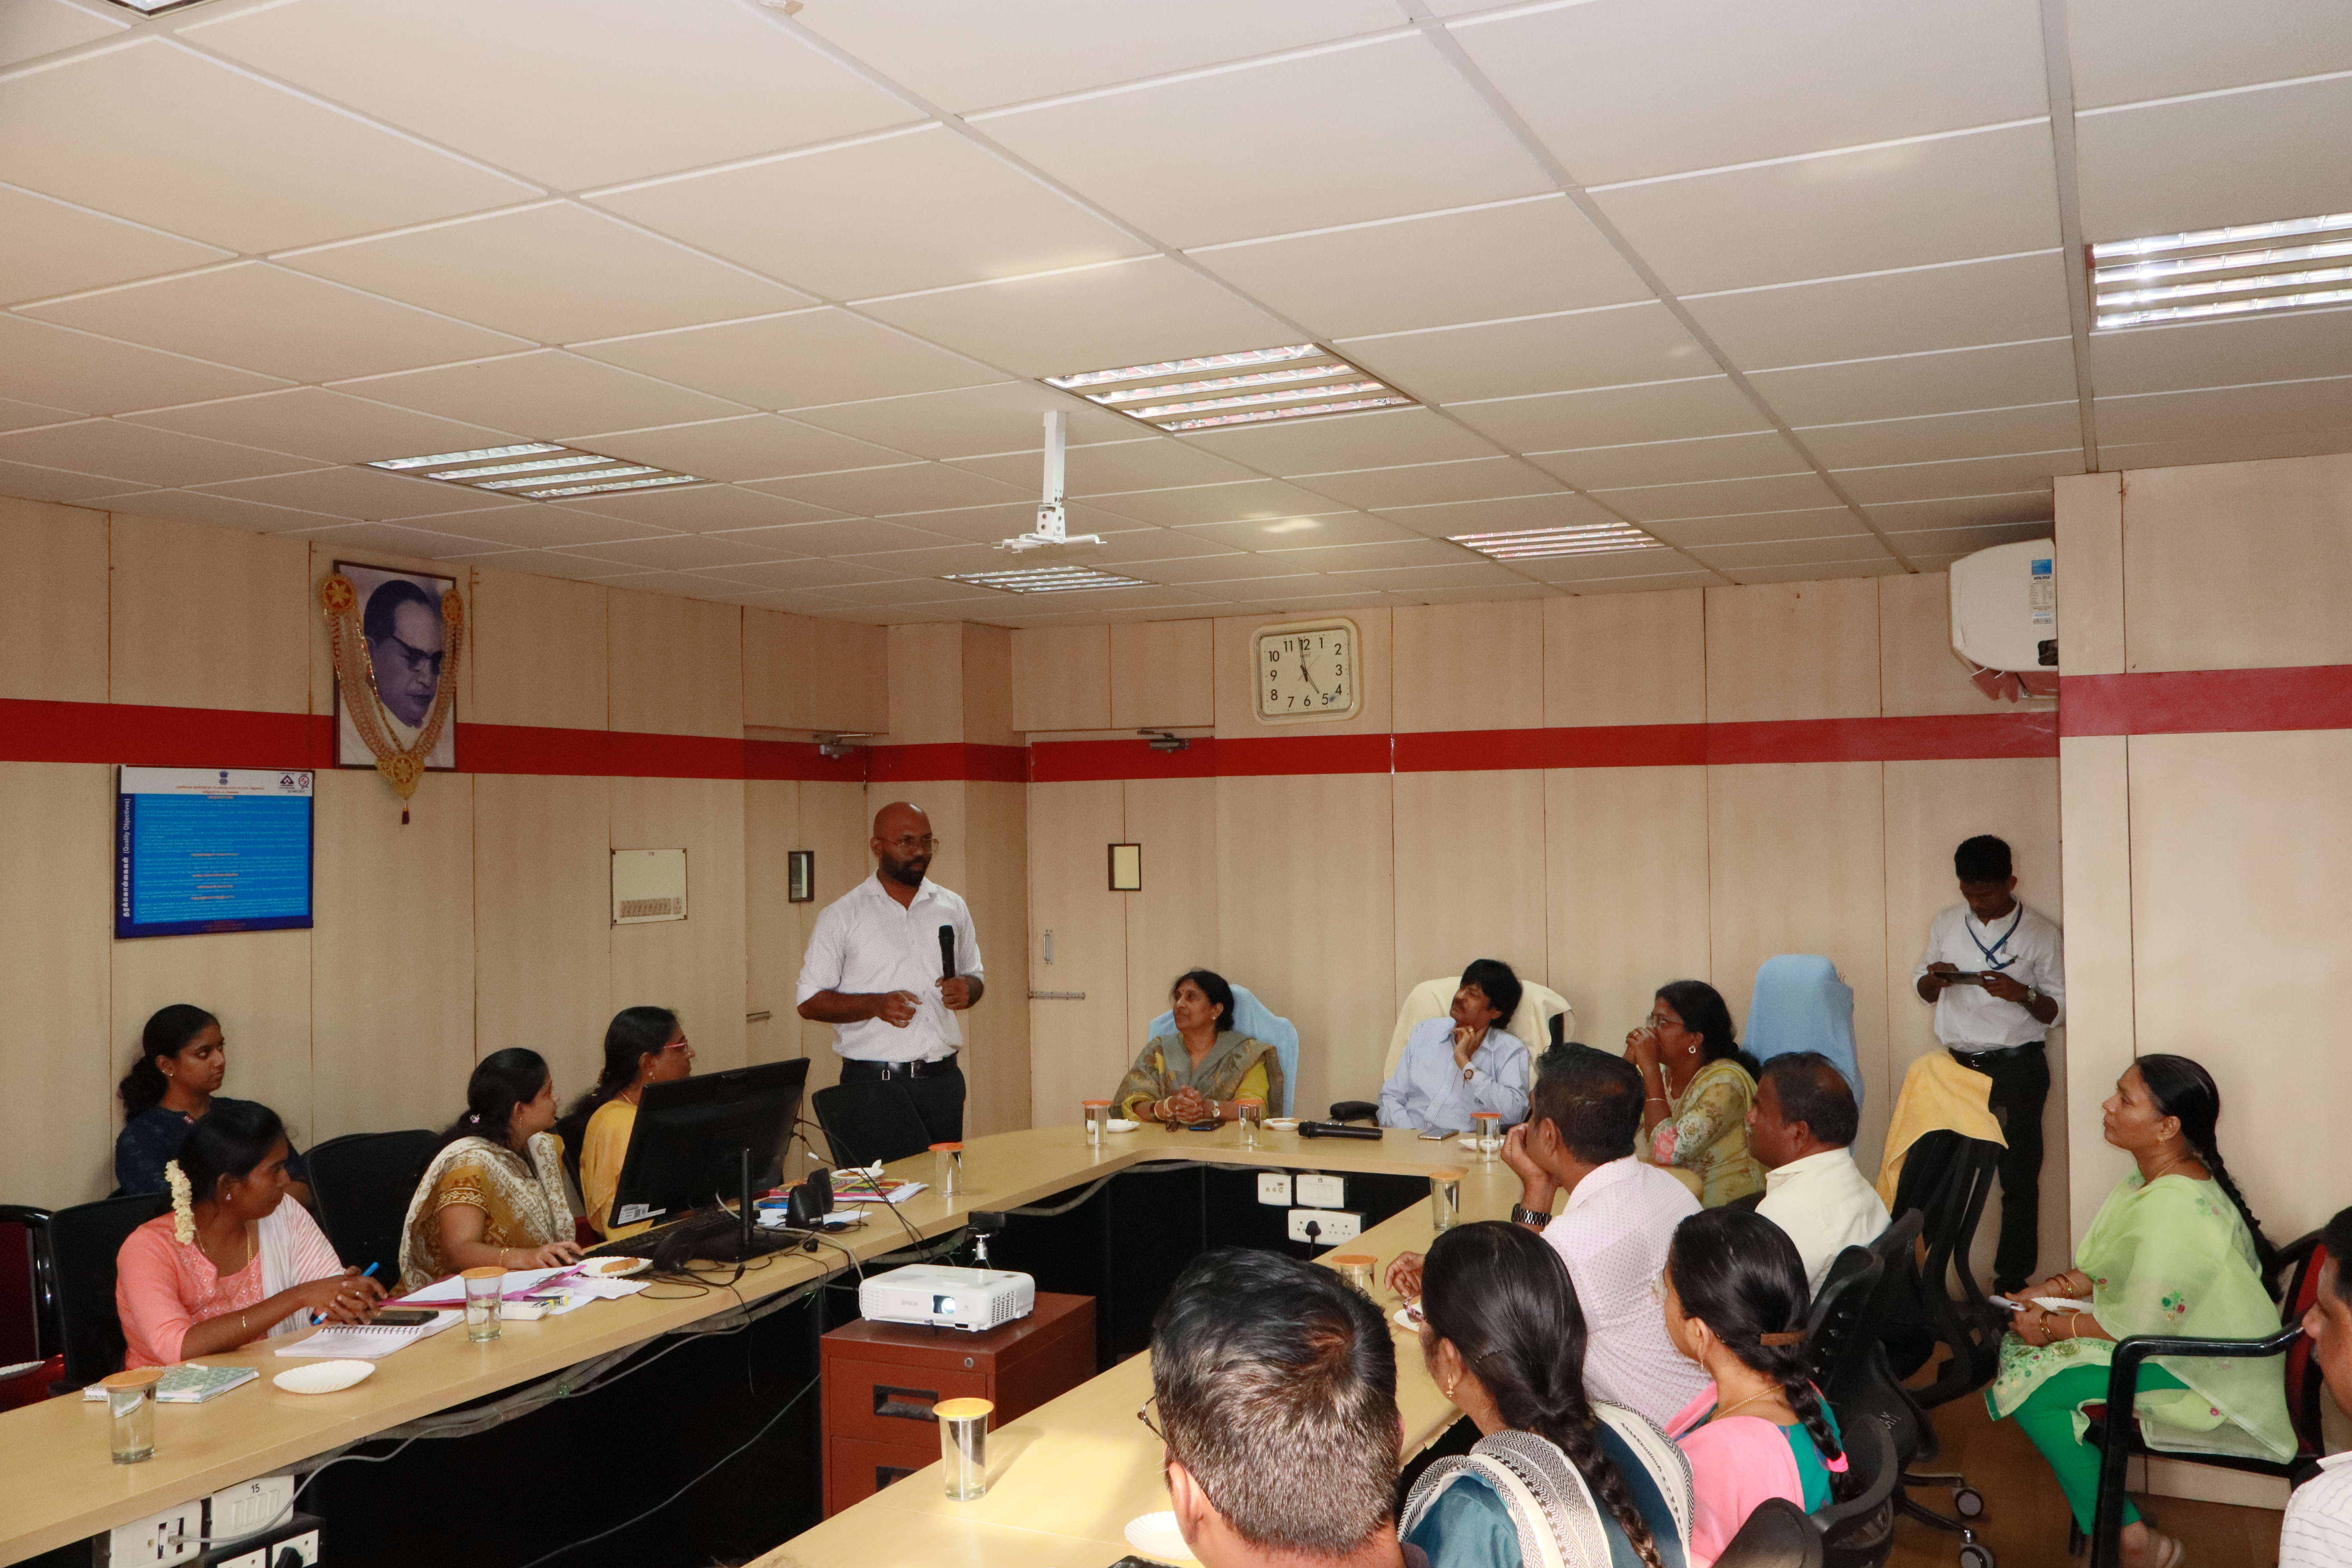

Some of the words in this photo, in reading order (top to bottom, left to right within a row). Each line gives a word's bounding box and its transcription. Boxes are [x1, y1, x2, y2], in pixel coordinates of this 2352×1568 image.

[1283, 640, 1293, 652] 11
[1299, 638, 1310, 651] 12
[1319, 637, 1323, 649] 1
[1334, 643, 1342, 655] 2
[1269, 650, 1279, 662] 10
[1270, 670, 1277, 681] 9
[1335, 664, 1343, 676] 3
[1271, 689, 1278, 701] 8
[1335, 684, 1343, 695] 4
[1287, 696, 1295, 708] 7
[1304, 695, 1311, 706] 6
[1322, 693, 1328, 705] 5
[251, 1483, 260, 1494] 15
